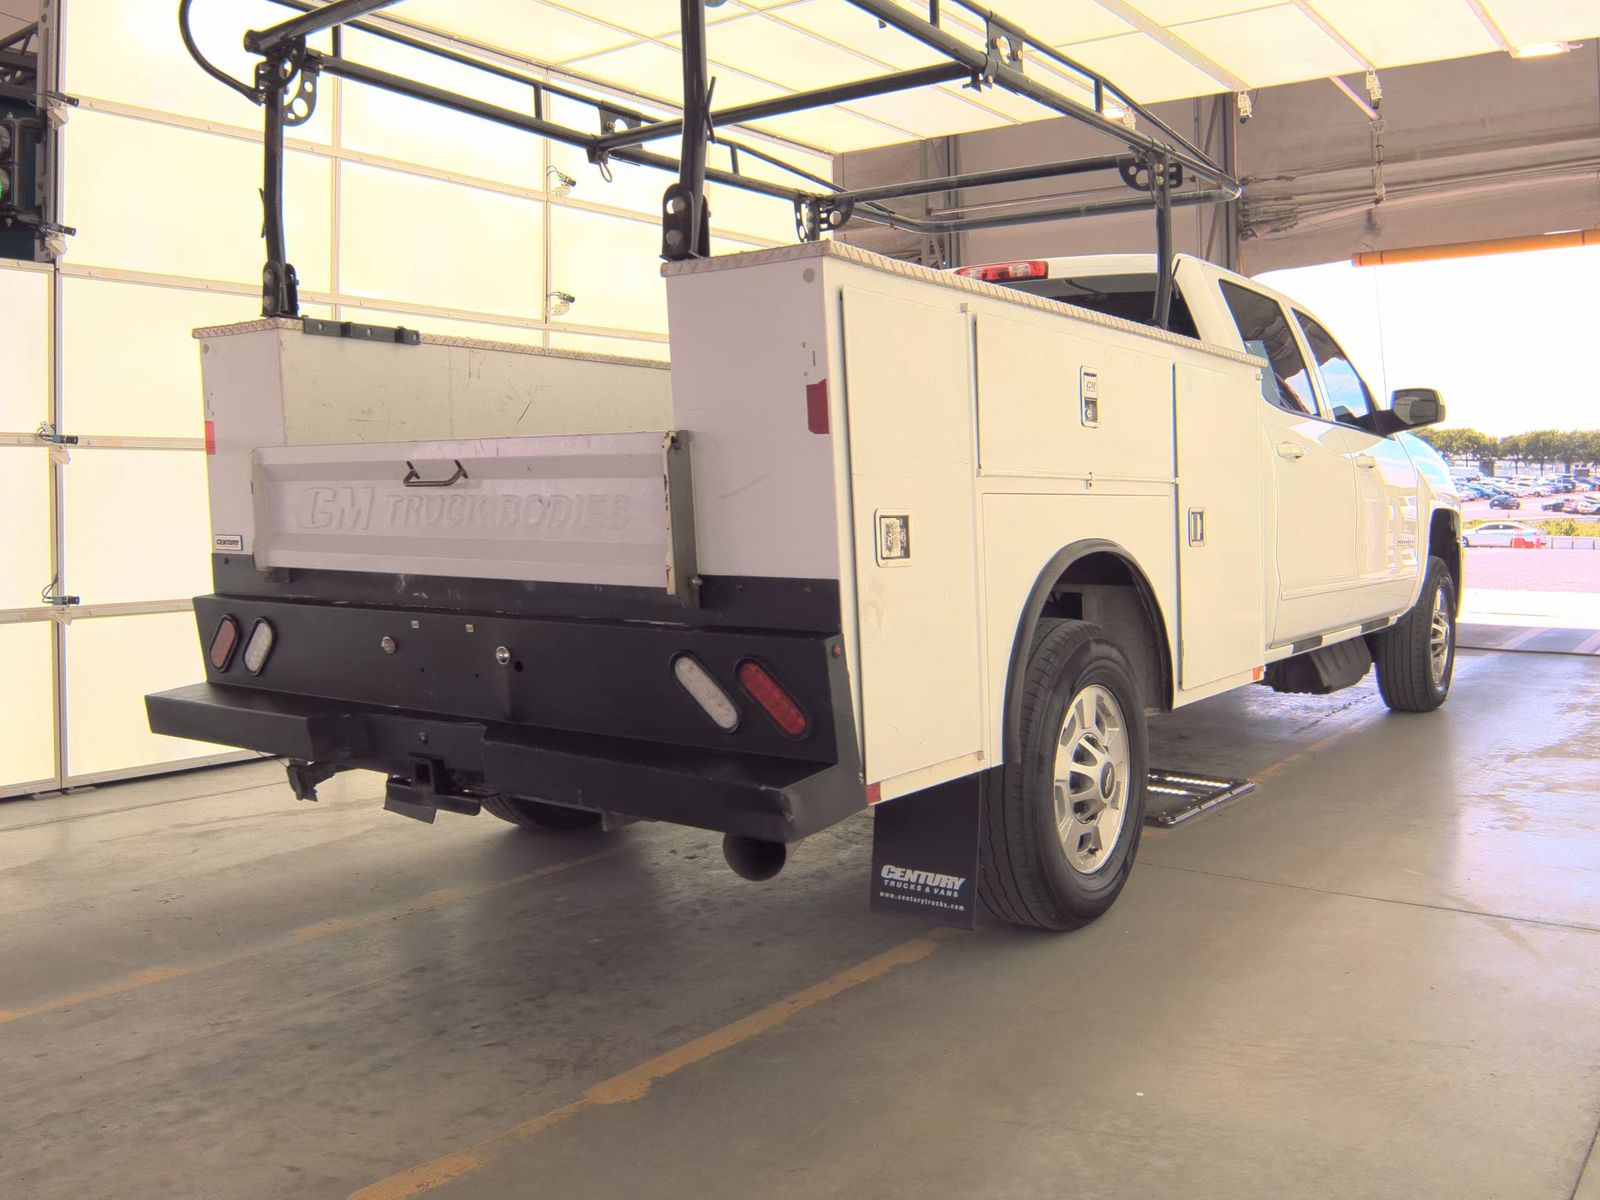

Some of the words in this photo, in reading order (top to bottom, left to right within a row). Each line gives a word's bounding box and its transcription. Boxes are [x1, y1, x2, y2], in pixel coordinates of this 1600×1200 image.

[384, 494, 489, 528] TRUCK
[497, 493, 632, 530] BODIES
[881, 865, 965, 890] CENTURY
[884, 880, 921, 892] TRUCKS
[933, 888, 959, 898] VANS
[880, 892, 964, 911] www.centurytrucks.com
